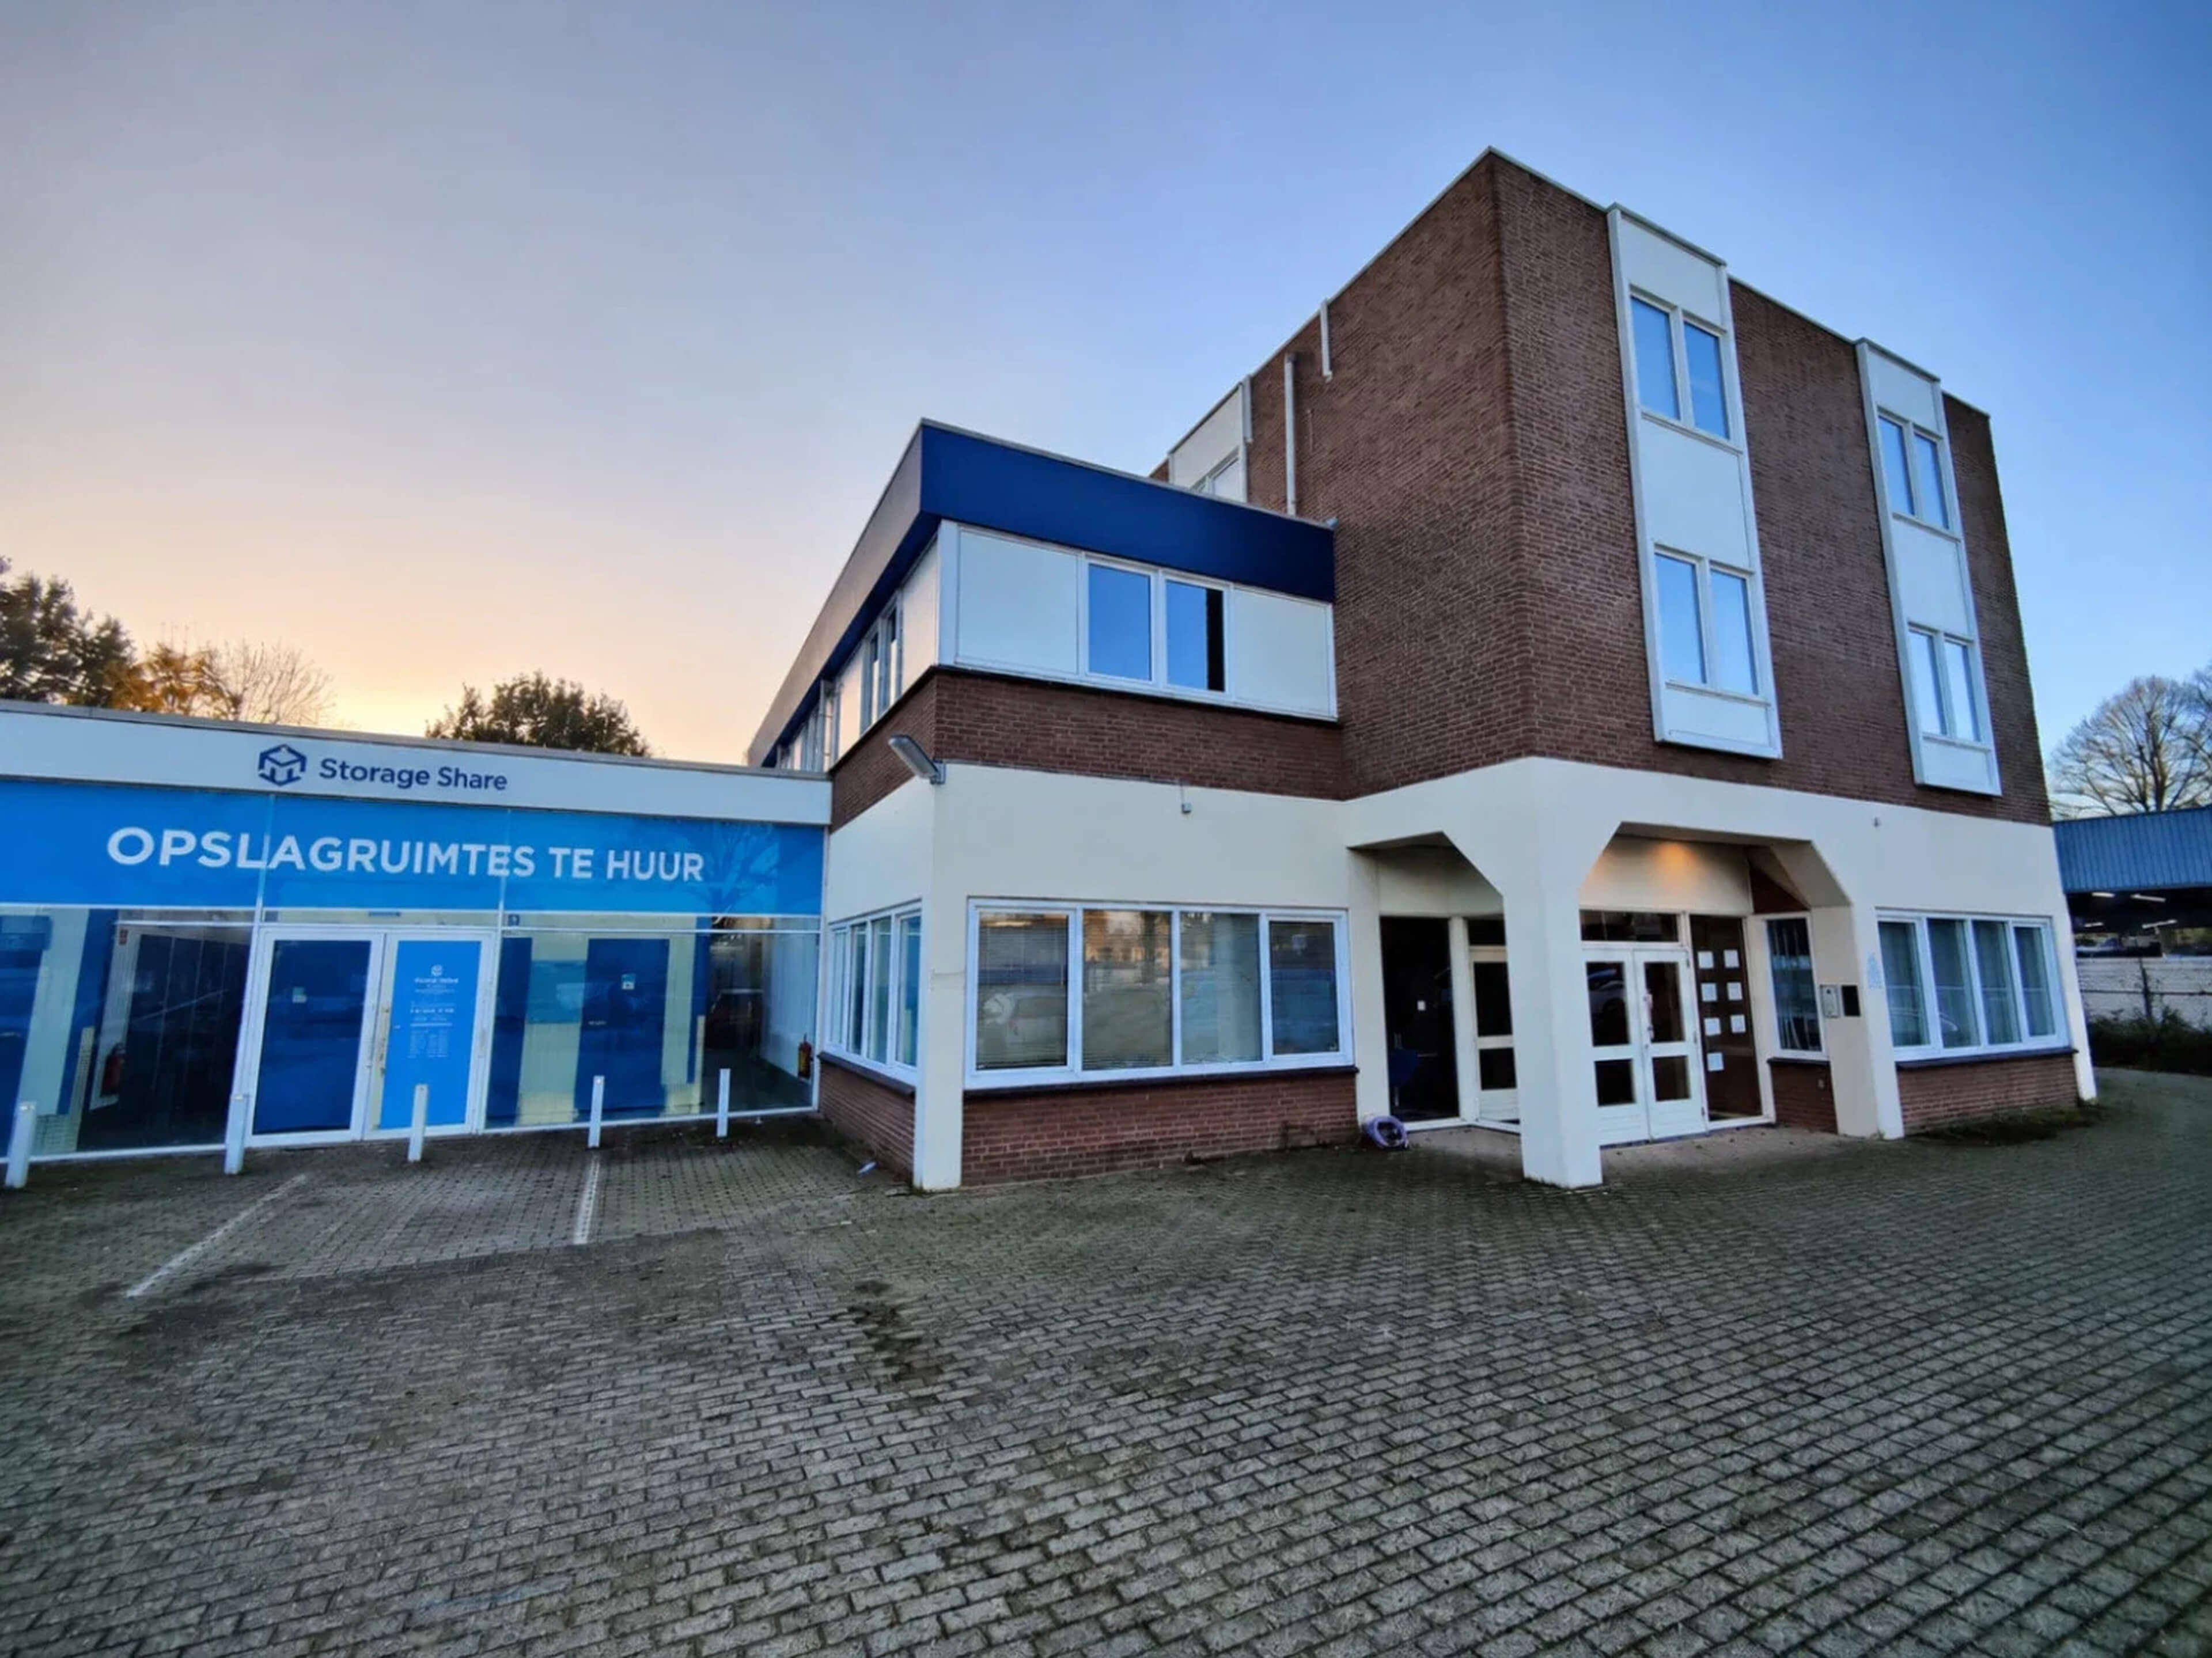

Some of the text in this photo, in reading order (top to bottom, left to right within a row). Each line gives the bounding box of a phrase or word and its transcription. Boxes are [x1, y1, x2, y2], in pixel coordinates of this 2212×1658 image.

[319, 758, 507, 791] Storage Share
[108, 827, 704, 881] OPSLAGRUIMTES TE HUUR
